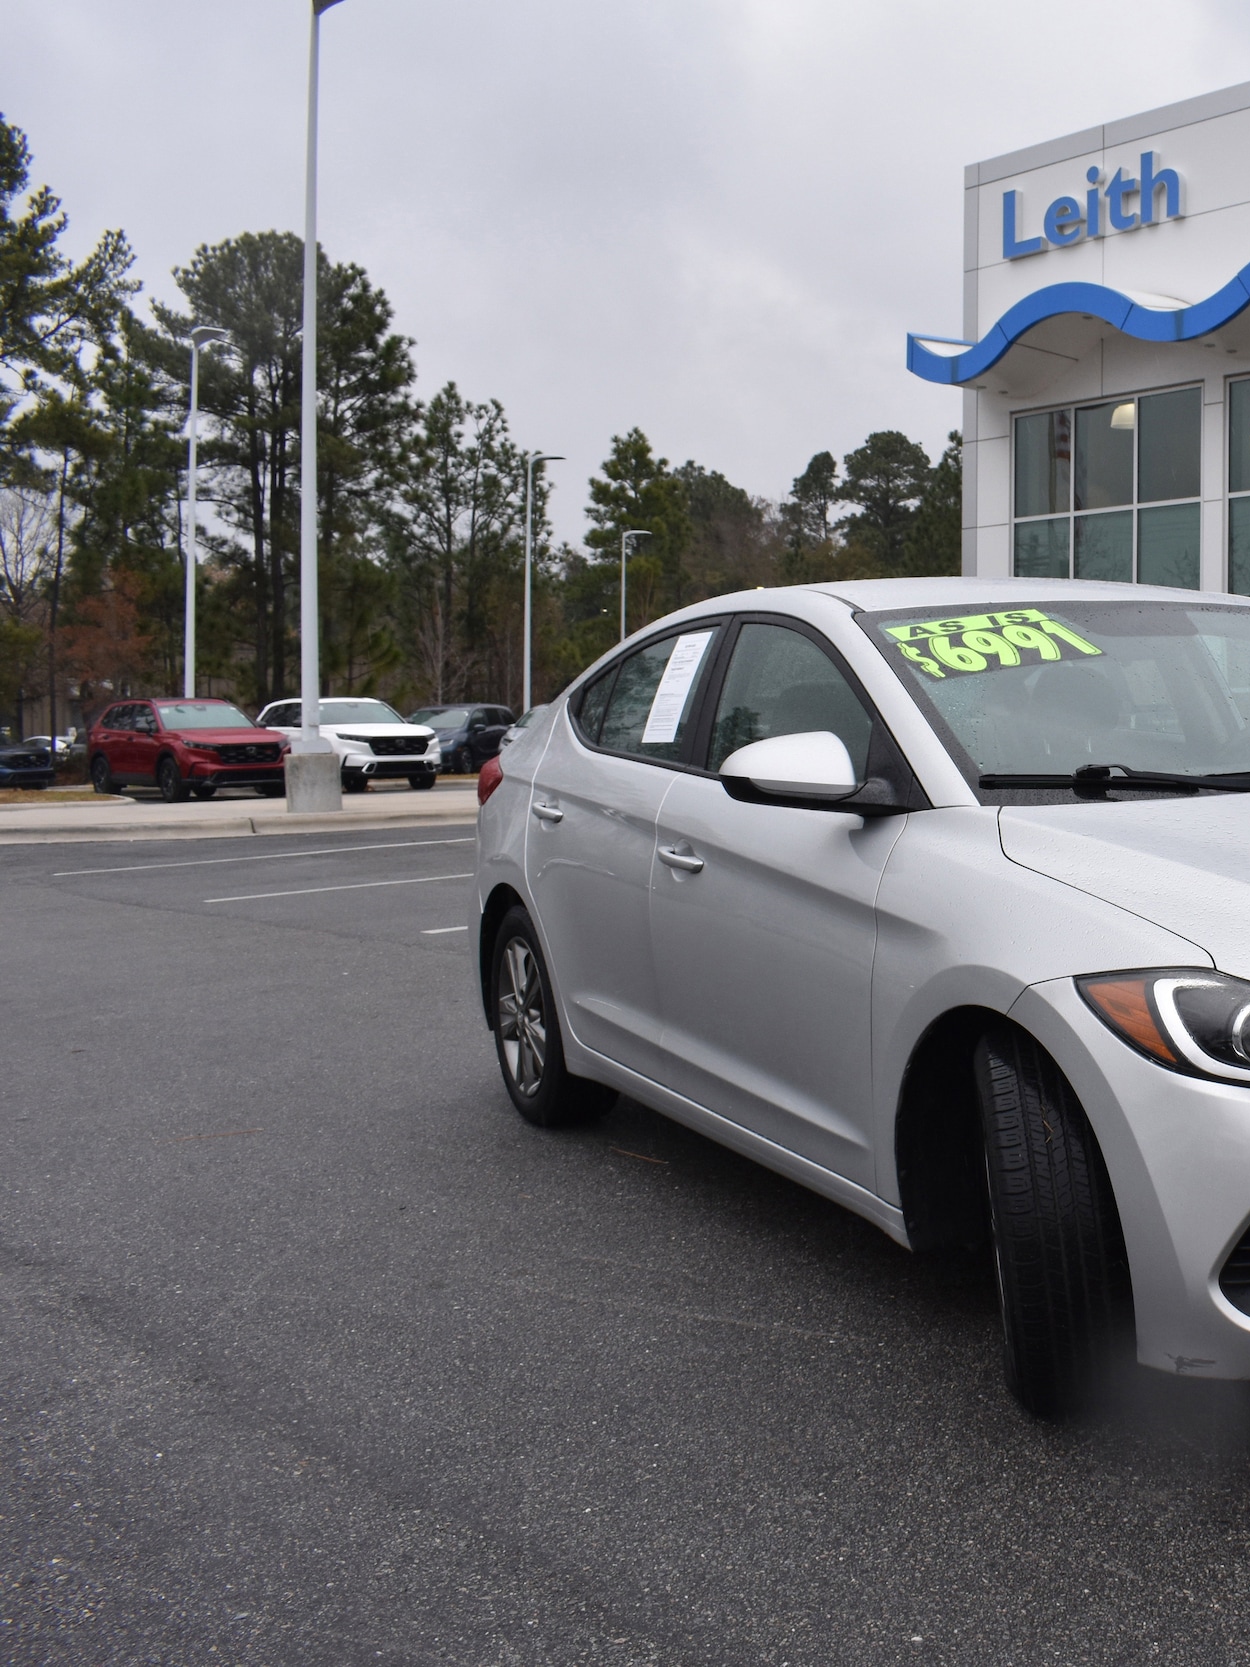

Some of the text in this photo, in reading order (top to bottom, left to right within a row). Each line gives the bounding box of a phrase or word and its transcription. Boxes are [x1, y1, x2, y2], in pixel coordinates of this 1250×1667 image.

[1003, 151, 1183, 259] Leith
[897, 619, 1102, 678] $6991
[909, 613, 1030, 638] AS IS
